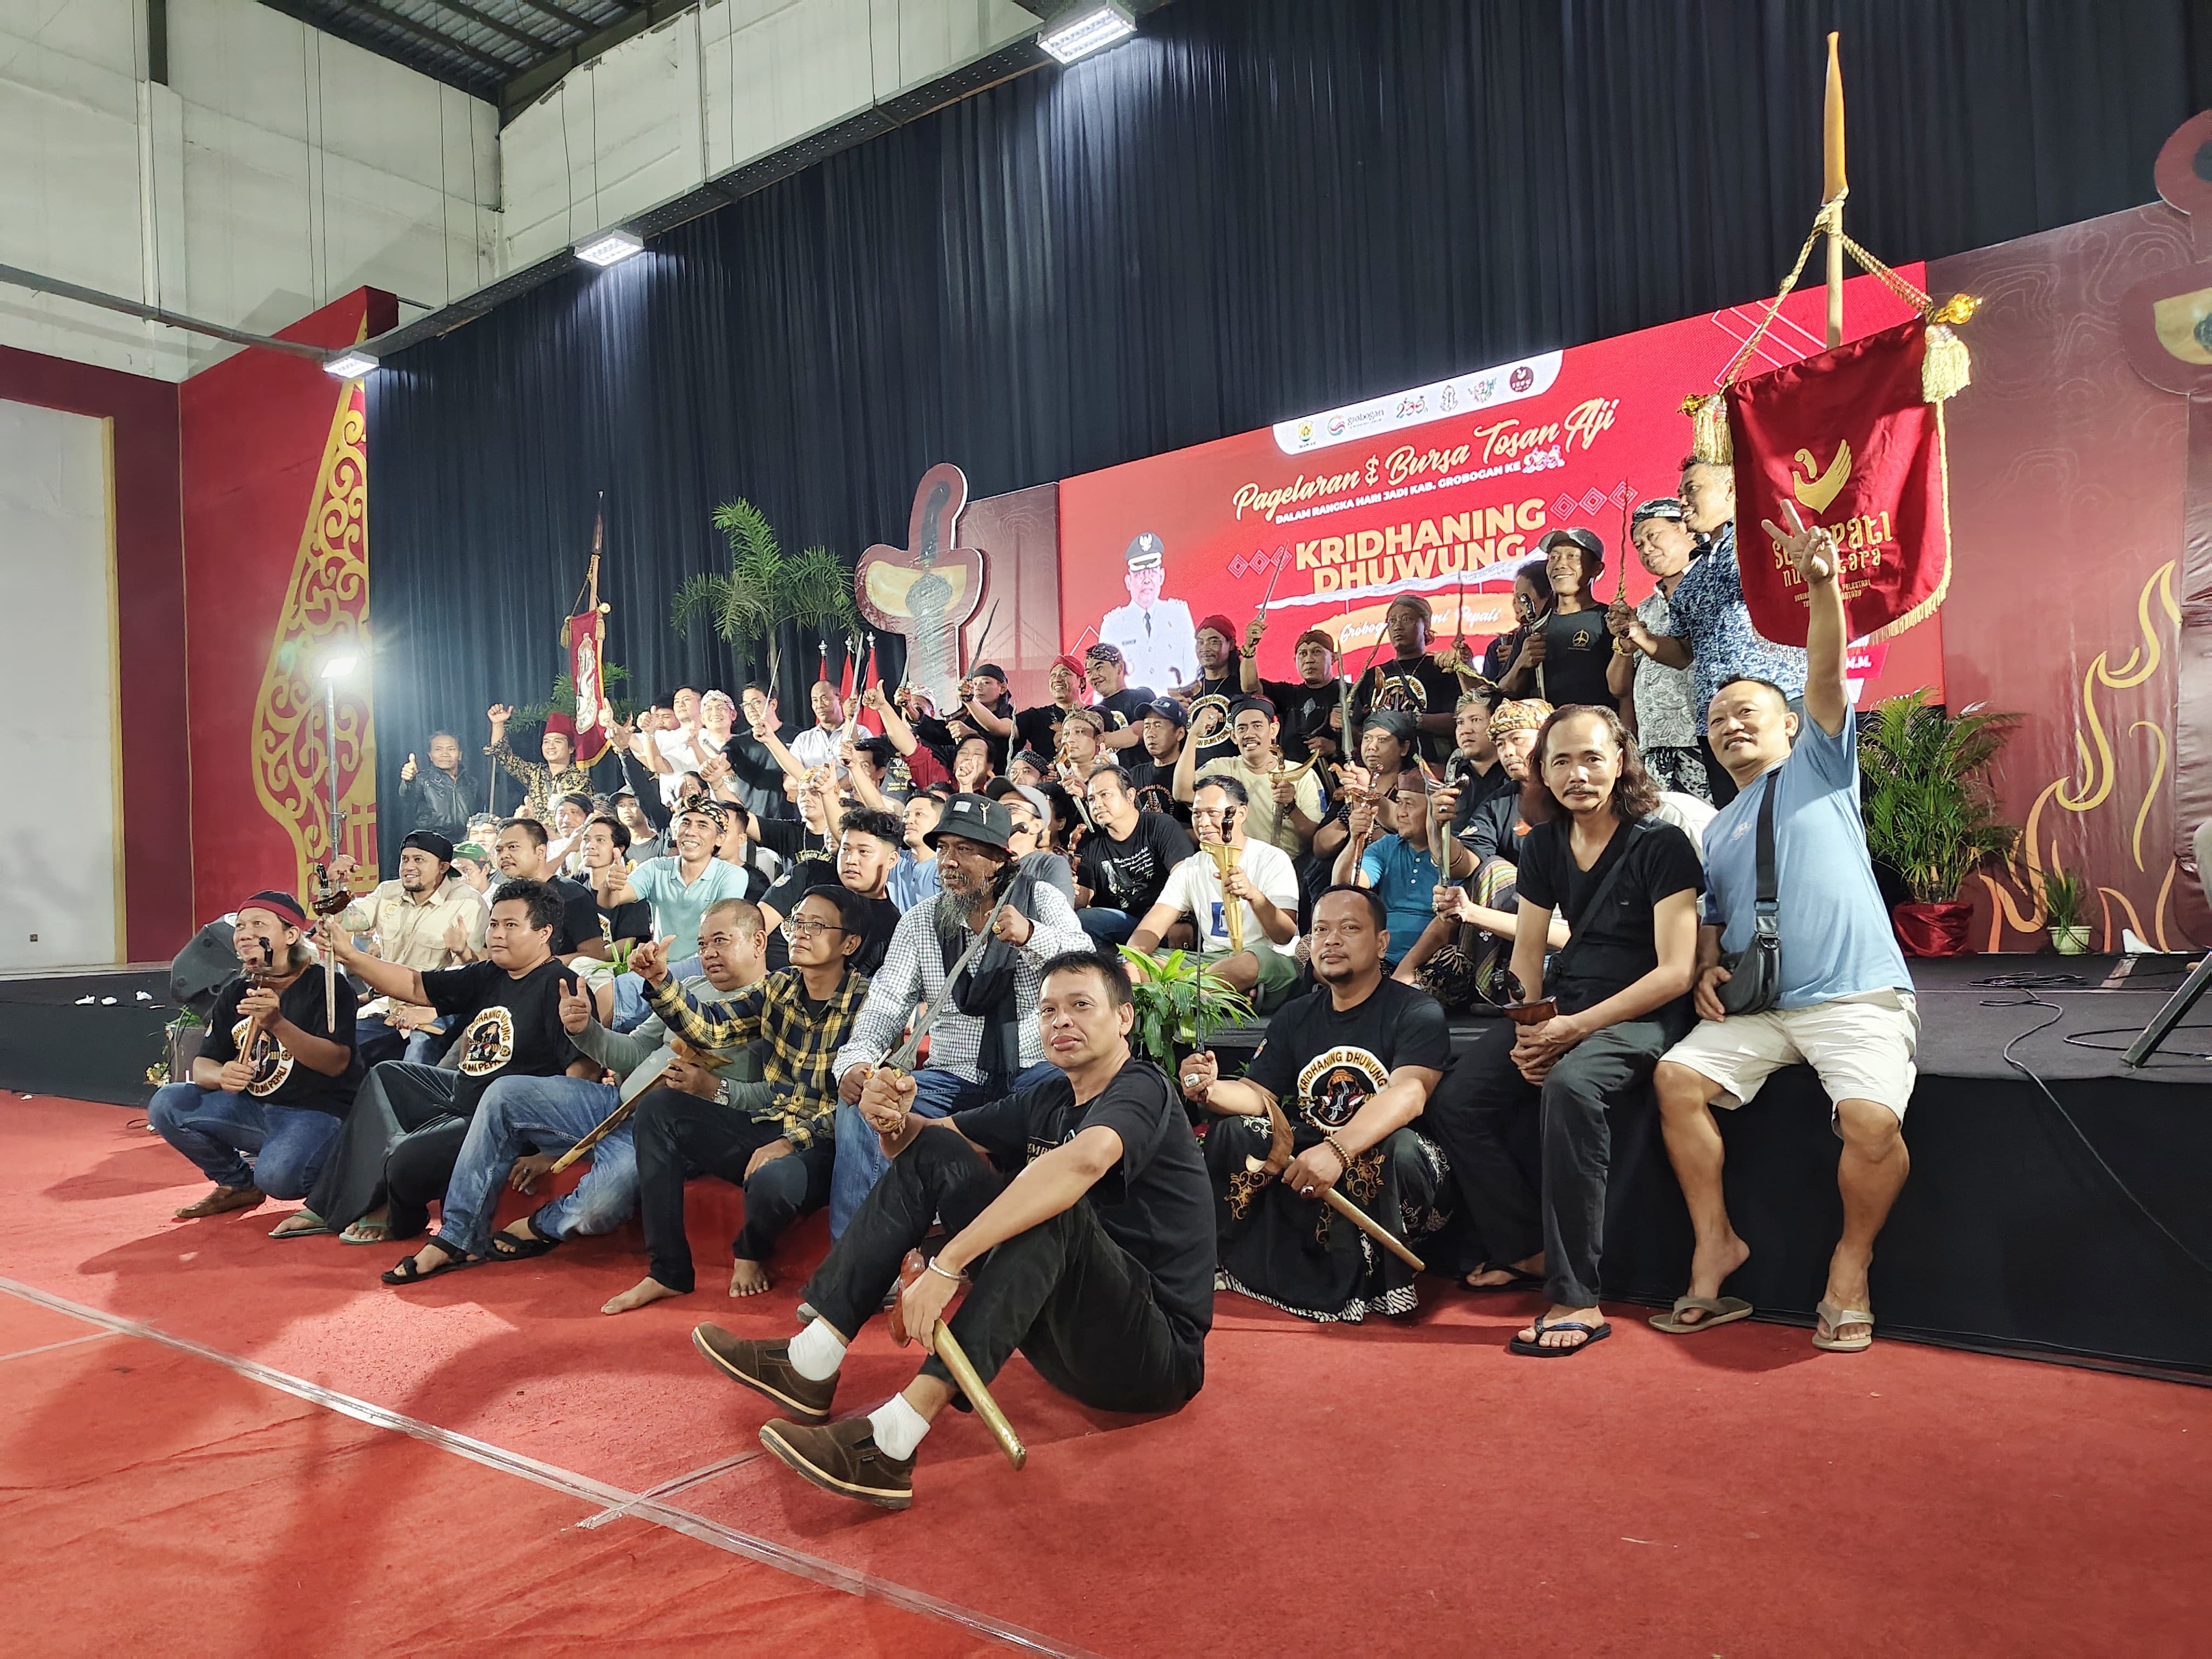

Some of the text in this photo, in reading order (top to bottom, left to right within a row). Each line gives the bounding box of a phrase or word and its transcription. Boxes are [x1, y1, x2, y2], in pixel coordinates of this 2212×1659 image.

[1232, 470, 1361, 521] Pagelaran
[1384, 444, 1472, 486] Bursa
[1473, 418, 1561, 464] Tosan
[1563, 397, 1620, 453] Aji
[1275, 508, 1311, 525] DALAM
[1312, 498, 1355, 517] RANGKA
[1355, 492, 1382, 507] HARI
[1384, 487, 1408, 501] JADI
[1410, 481, 1437, 495] KAB.
[1438, 464, 1503, 488] GROBOGAN
[1504, 460, 1521, 473] KE
[1296, 498, 1547, 571] KRIDHANING
[1313, 534, 1526, 595] DHUWUNG
[1340, 621, 1389, 643] Grobog
[1300, 1051, 1388, 1094] KRIDHANING DHUWUNG
